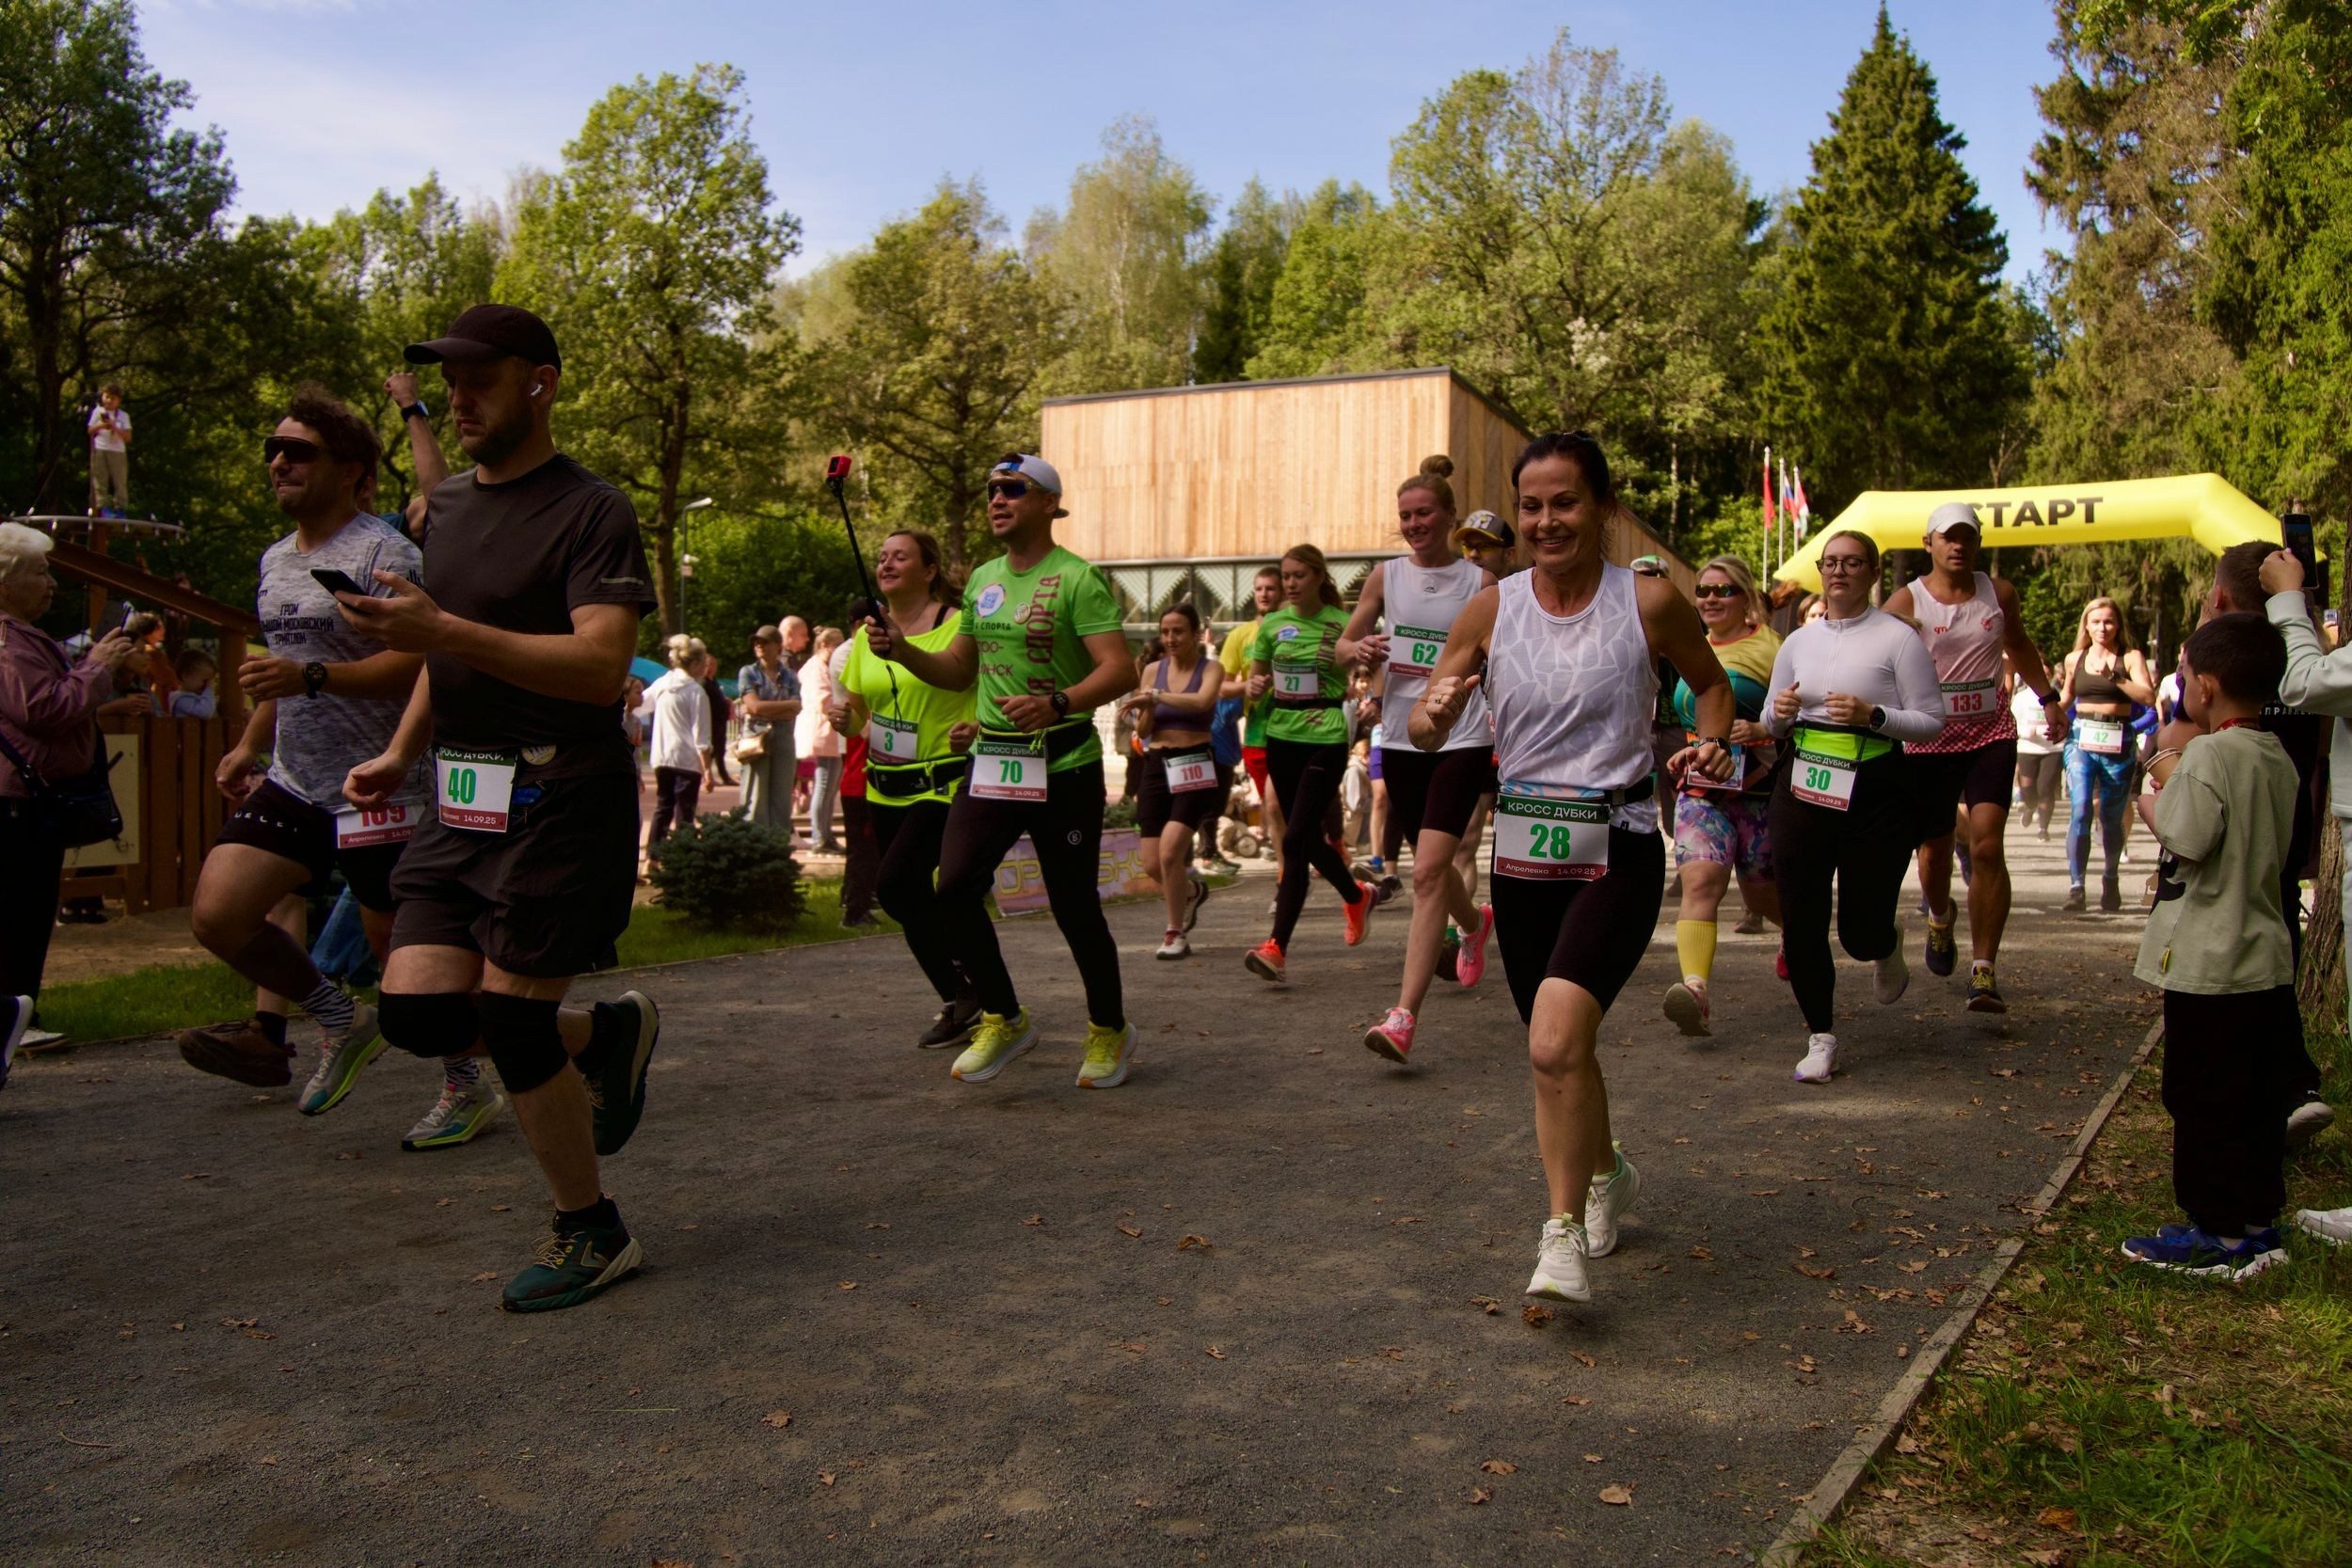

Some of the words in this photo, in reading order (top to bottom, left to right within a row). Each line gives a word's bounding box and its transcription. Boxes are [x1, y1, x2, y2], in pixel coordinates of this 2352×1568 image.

[280, 603, 299, 616] ГРОМ
[283, 616, 335, 632] МОСКОВСКИЙ
[981, 622, 1011, 631] СПОРТА
[1025, 573, 1061, 664] СПОРТА
[1401, 628, 1428, 638] КРОСС
[1411, 642, 1438, 665] 62
[1284, 676, 1300, 691] 27
[1950, 693, 1982, 712] 133
[884, 731, 893, 752] 3
[2093, 732, 2108, 743] 42
[1821, 757, 1851, 768] ДУБКИ
[999, 760, 1023, 784] 70
[1181, 765, 1202, 781] 110
[1806, 767, 1832, 791] 30
[448, 768, 476, 804] 40
[1507, 801, 1551, 816] КРОСС
[1553, 806, 1597, 820] ДУБКИ
[464, 815, 497, 825] 14.09.25
[1529, 823, 1571, 860] 28
[1505, 863, 1549, 875] Апрелевка
[1557, 867, 1597, 876] 14.09.25
